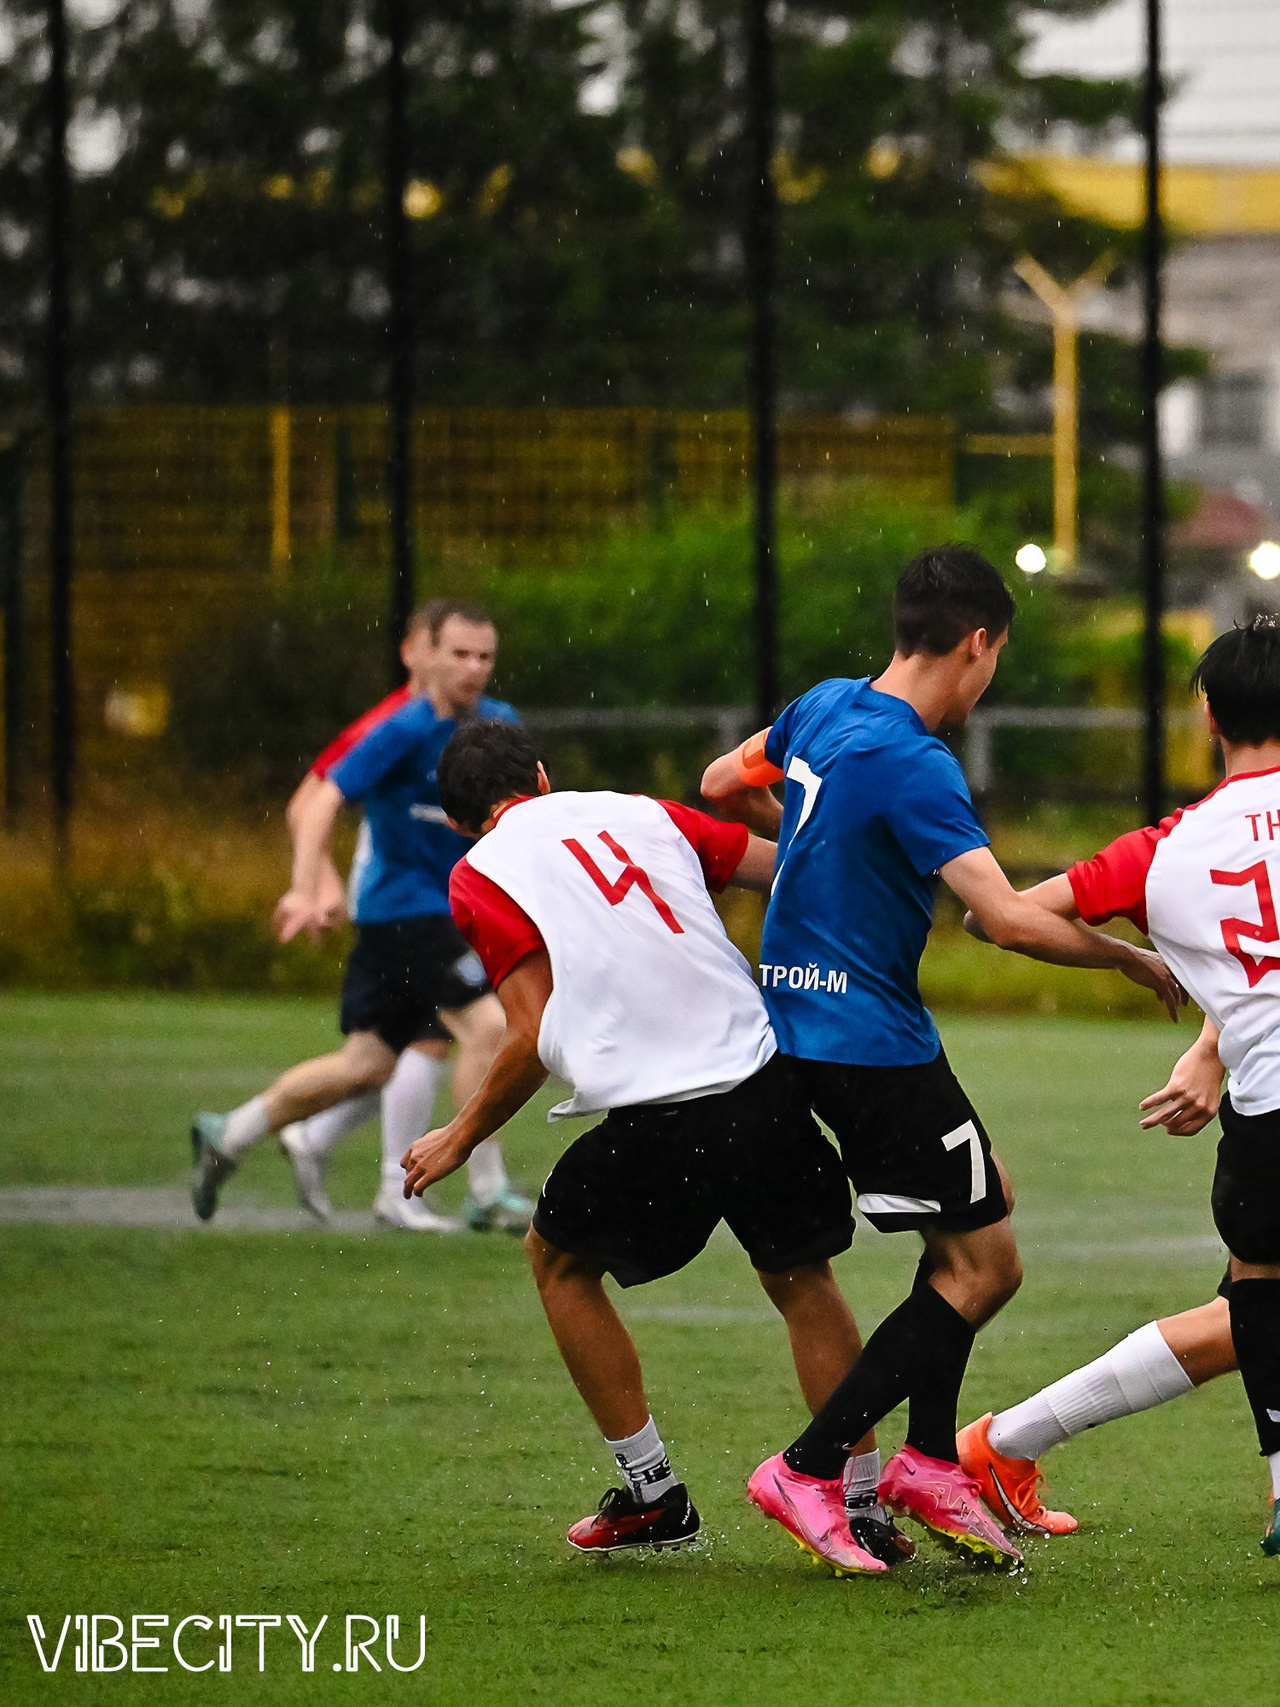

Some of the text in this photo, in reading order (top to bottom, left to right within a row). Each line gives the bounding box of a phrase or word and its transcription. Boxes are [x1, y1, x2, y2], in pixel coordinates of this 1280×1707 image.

[770, 755, 823, 896] 7
[561, 830, 685, 934] 4
[940, 1118, 987, 1205] 7
